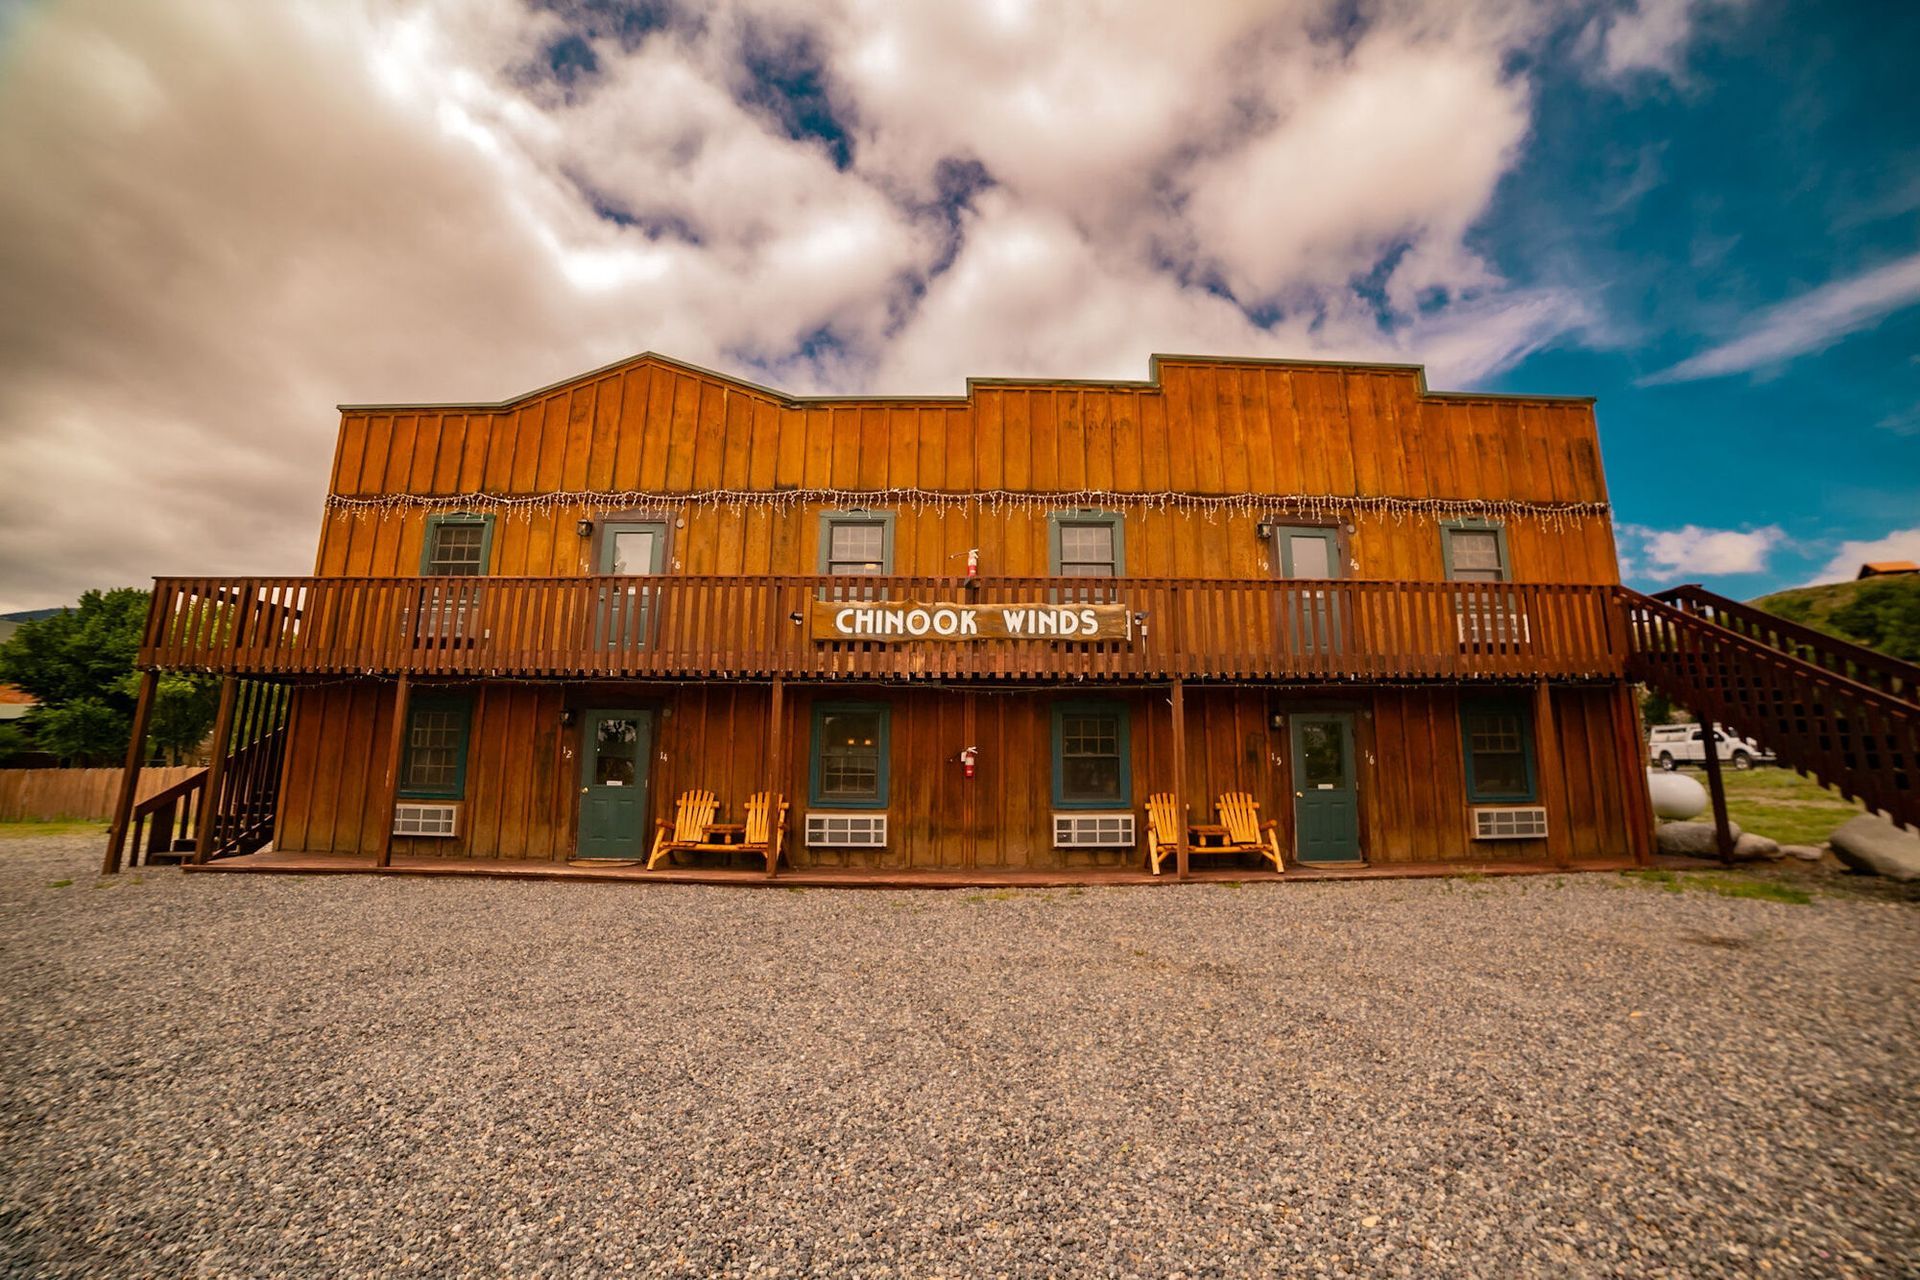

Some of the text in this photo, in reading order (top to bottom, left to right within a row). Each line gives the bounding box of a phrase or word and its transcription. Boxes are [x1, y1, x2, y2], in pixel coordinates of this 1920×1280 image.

[835, 608, 1099, 636] CHINOOK WINDS
[562, 745, 573, 759] 12
[1270, 752, 1282, 766] 15
[1364, 749, 1375, 766] 16
